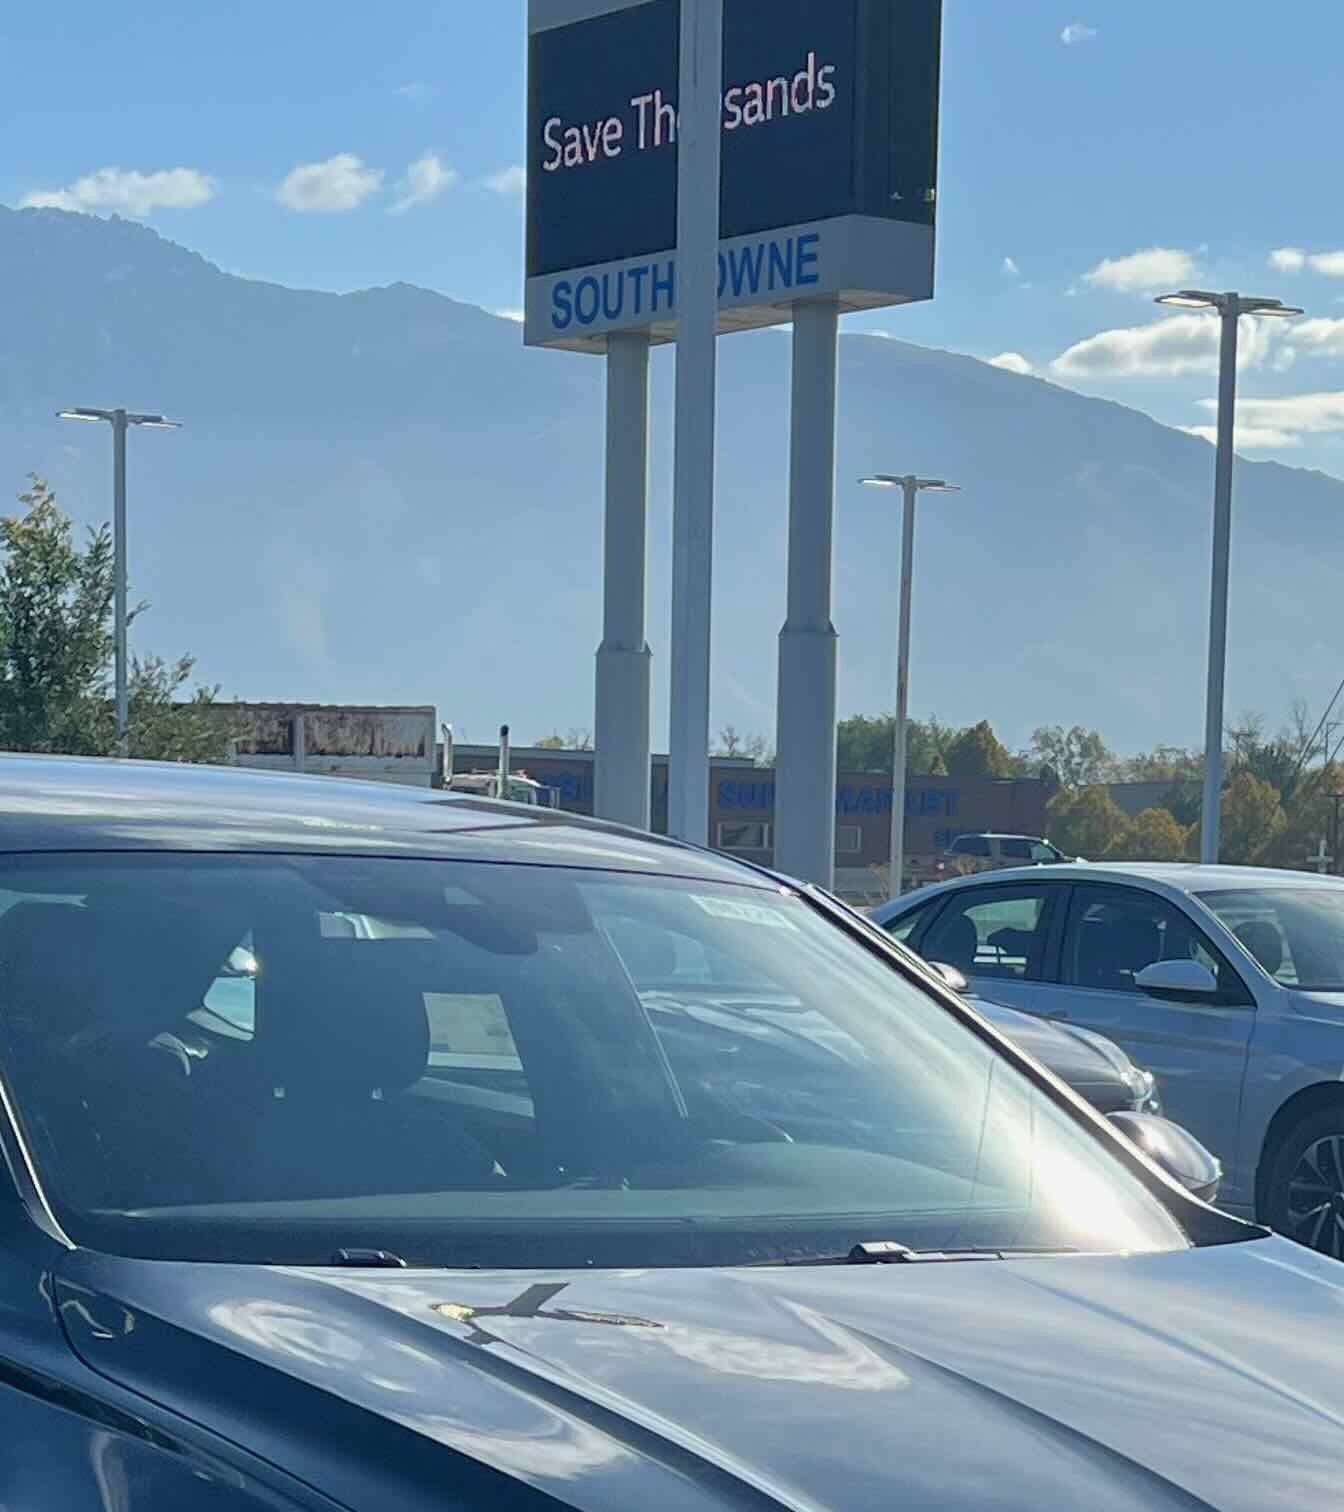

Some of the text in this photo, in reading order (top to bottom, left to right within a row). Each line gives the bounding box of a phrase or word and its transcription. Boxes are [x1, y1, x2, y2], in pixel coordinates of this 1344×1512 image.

[542, 51, 836, 171] Save Thsands
[551, 232, 820, 330] SOUTHWNE
